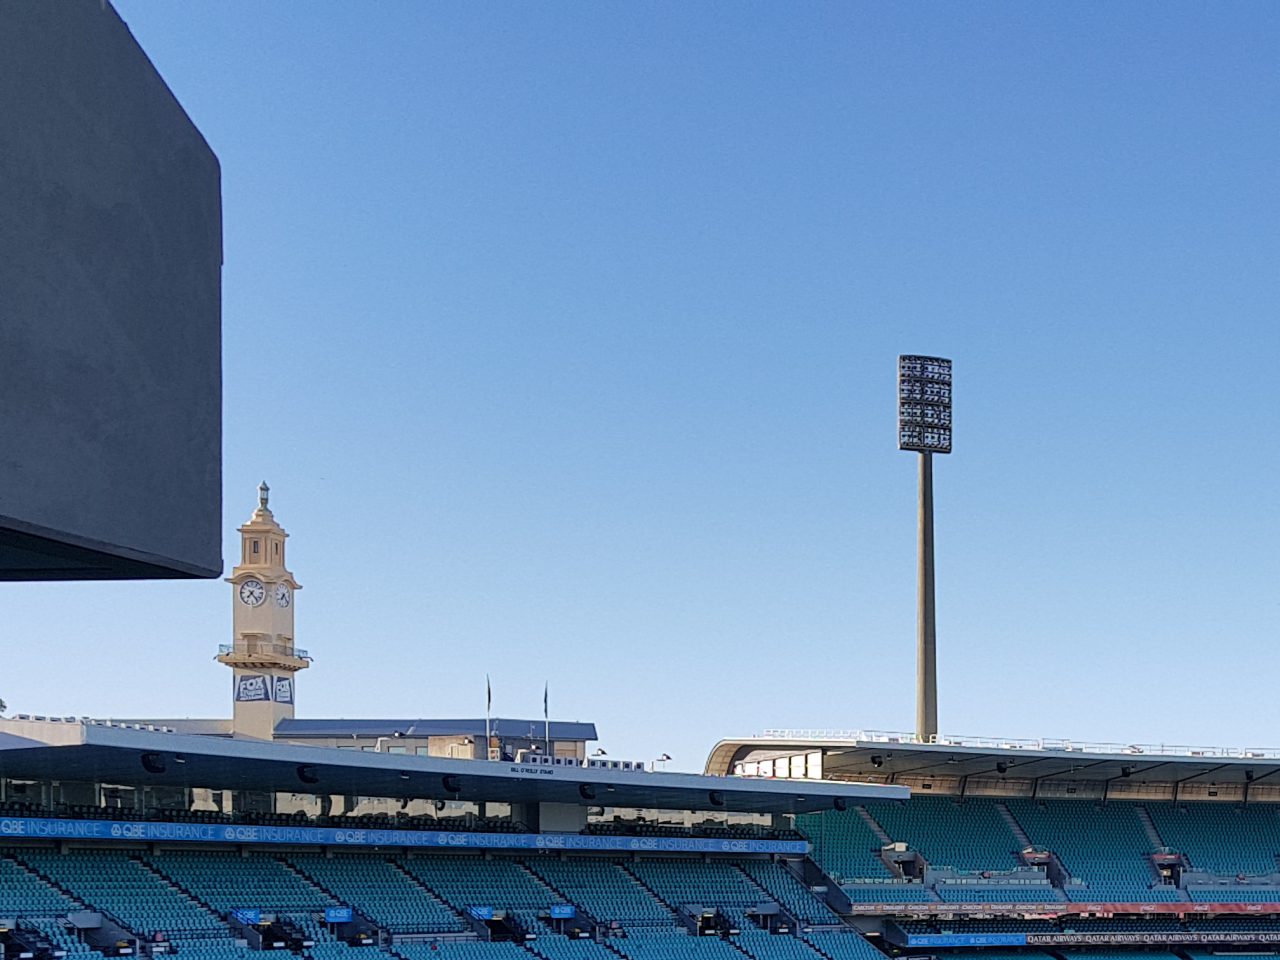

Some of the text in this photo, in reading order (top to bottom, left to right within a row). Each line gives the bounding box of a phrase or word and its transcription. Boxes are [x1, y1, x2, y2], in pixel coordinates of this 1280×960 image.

[240, 677, 264, 690] FOX
[1, 820, 100, 836] QBE INSURANCE
[123, 823, 215, 839] QBE INSURANCE
[236, 827, 324, 842] QBE INSURANCE
[345, 832, 428, 844] QBE INSURANCE
[448, 835, 527, 847] QBE INSURANCE
[546, 837, 622, 848] QBE INSURANCE
[640, 838, 714, 850] QBE INSURANCE
[731, 840, 801, 851] QBE INSURANCE
